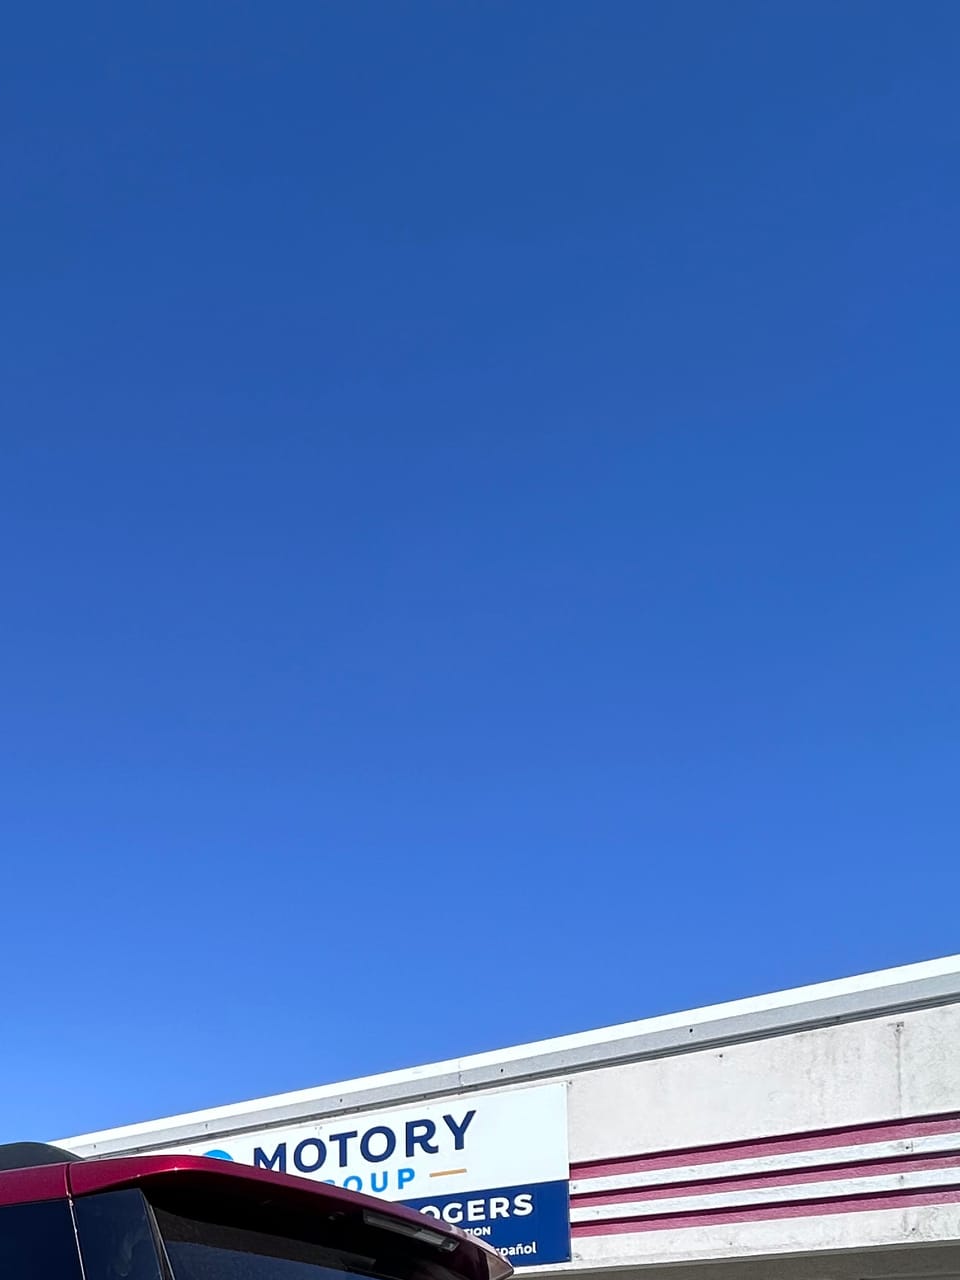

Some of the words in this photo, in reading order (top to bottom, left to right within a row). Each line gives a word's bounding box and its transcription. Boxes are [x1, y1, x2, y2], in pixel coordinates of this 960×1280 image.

[253, 1110, 477, 1174] MOTORY
[323, 1168, 416, 1193] OUP
[497, 1241, 537, 1257] pañol
